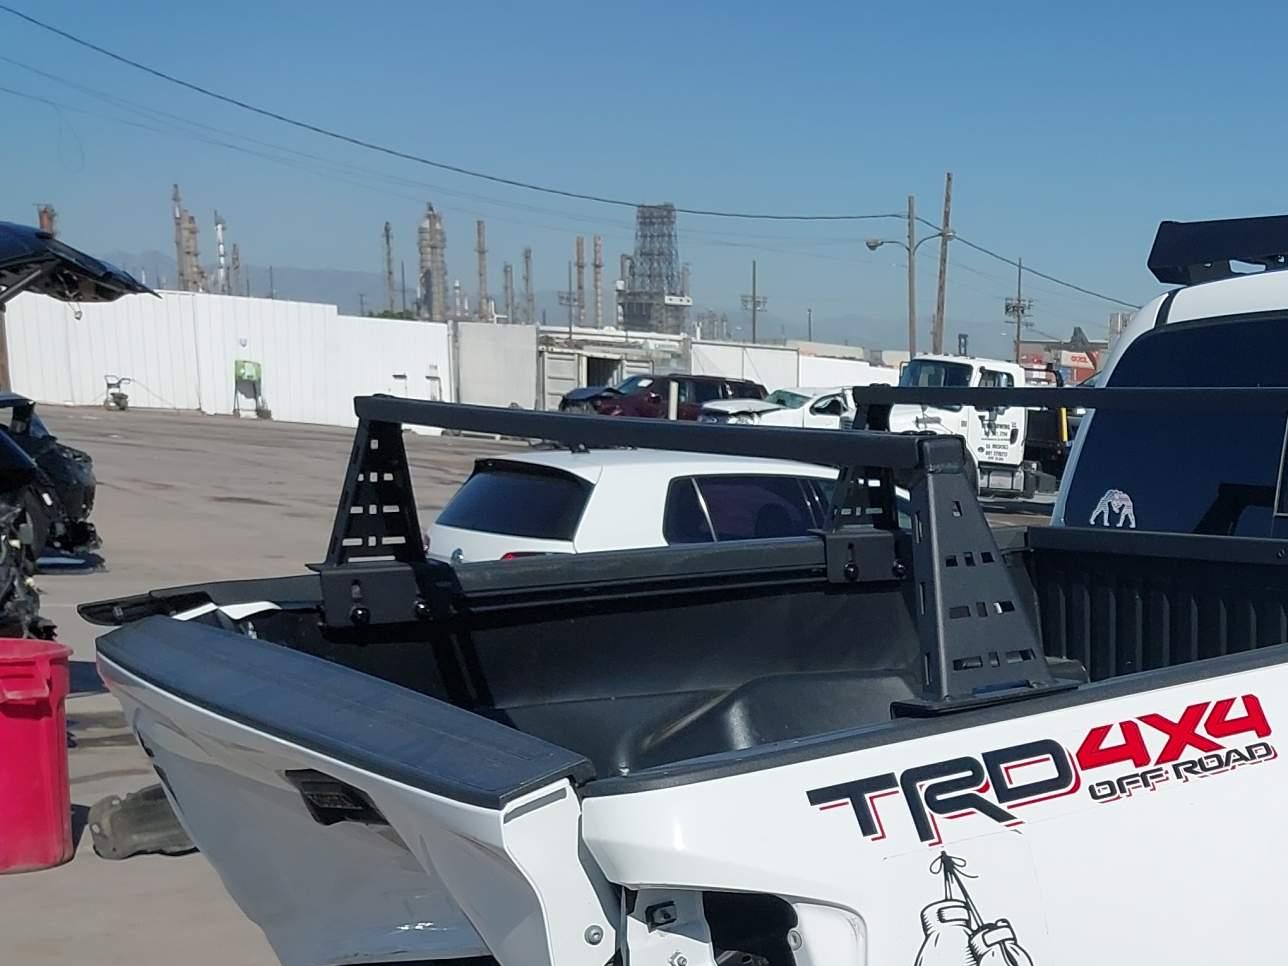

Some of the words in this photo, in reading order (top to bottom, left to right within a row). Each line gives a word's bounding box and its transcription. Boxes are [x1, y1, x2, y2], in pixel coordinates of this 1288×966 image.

[806, 738, 1081, 847] TRD
[1075, 693, 1274, 772] 4X4
[1088, 767, 1169, 804] OFF
[1174, 742, 1278, 783] ROAD
